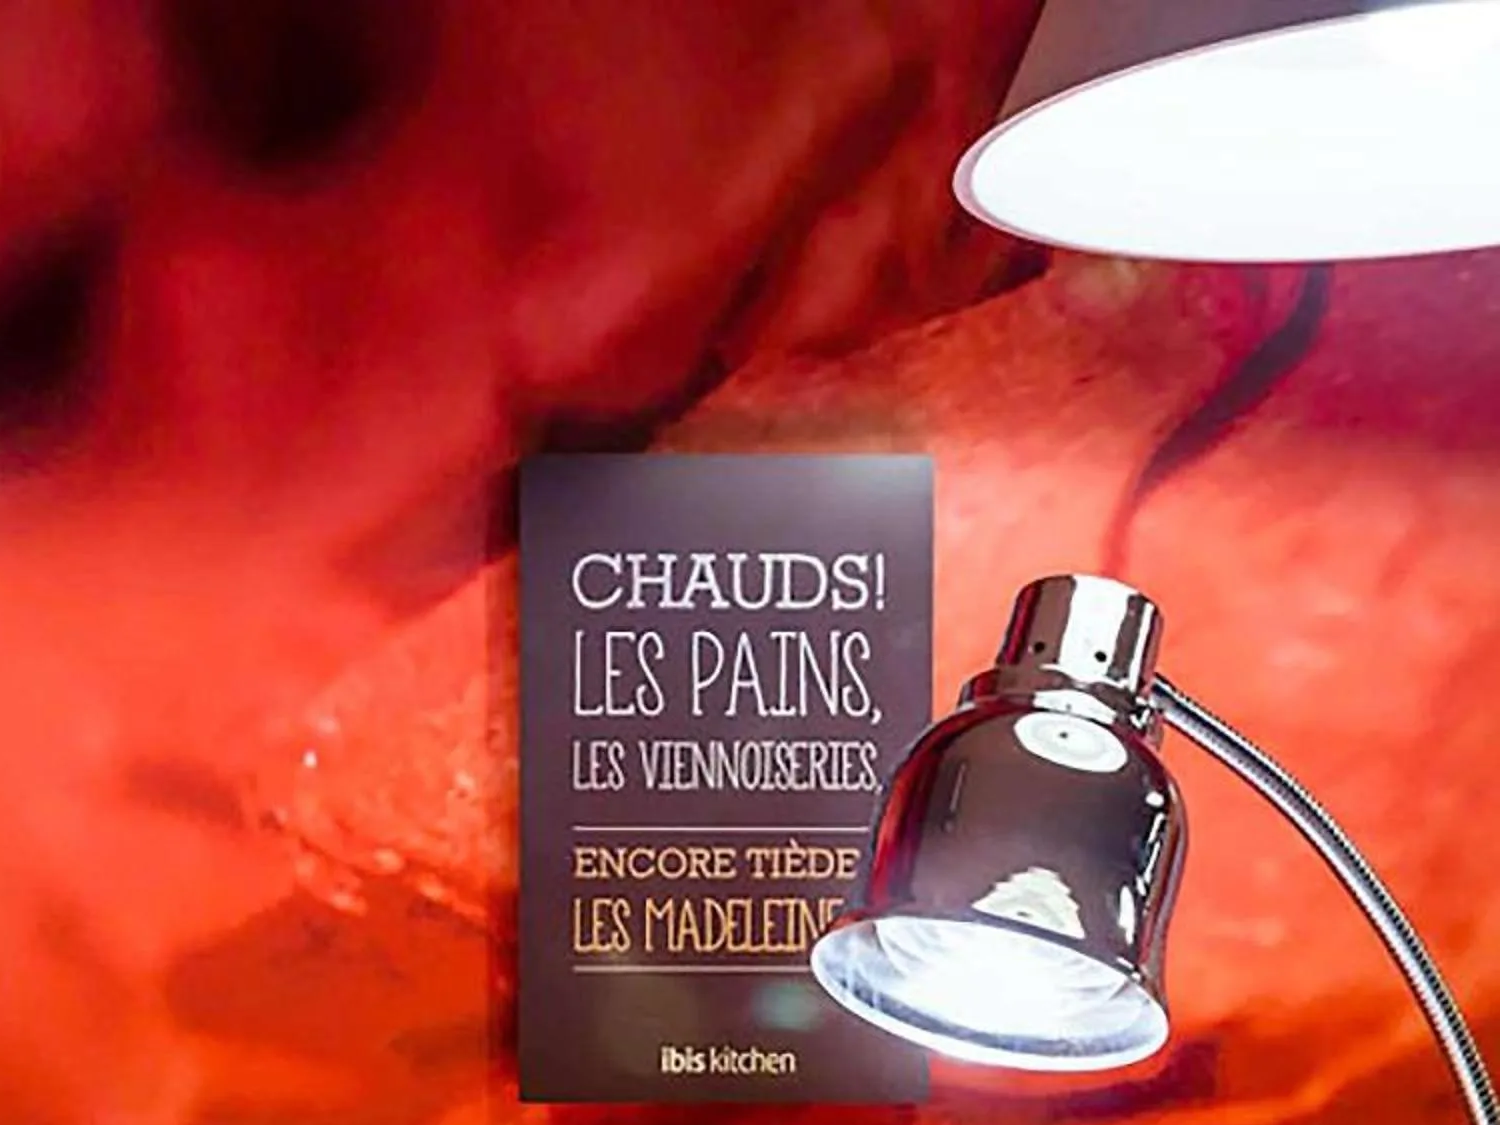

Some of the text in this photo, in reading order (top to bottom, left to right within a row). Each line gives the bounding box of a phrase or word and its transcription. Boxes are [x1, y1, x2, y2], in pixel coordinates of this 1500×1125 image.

[571, 553, 885, 611] CHAUDS!
[574, 630, 883, 725] LES PAINS,
[572, 741, 626, 791] LES
[574, 847, 737, 880] ENCORE
[573, 898, 632, 952] LES
[661, 1047, 797, 1074] ibis kitchen
